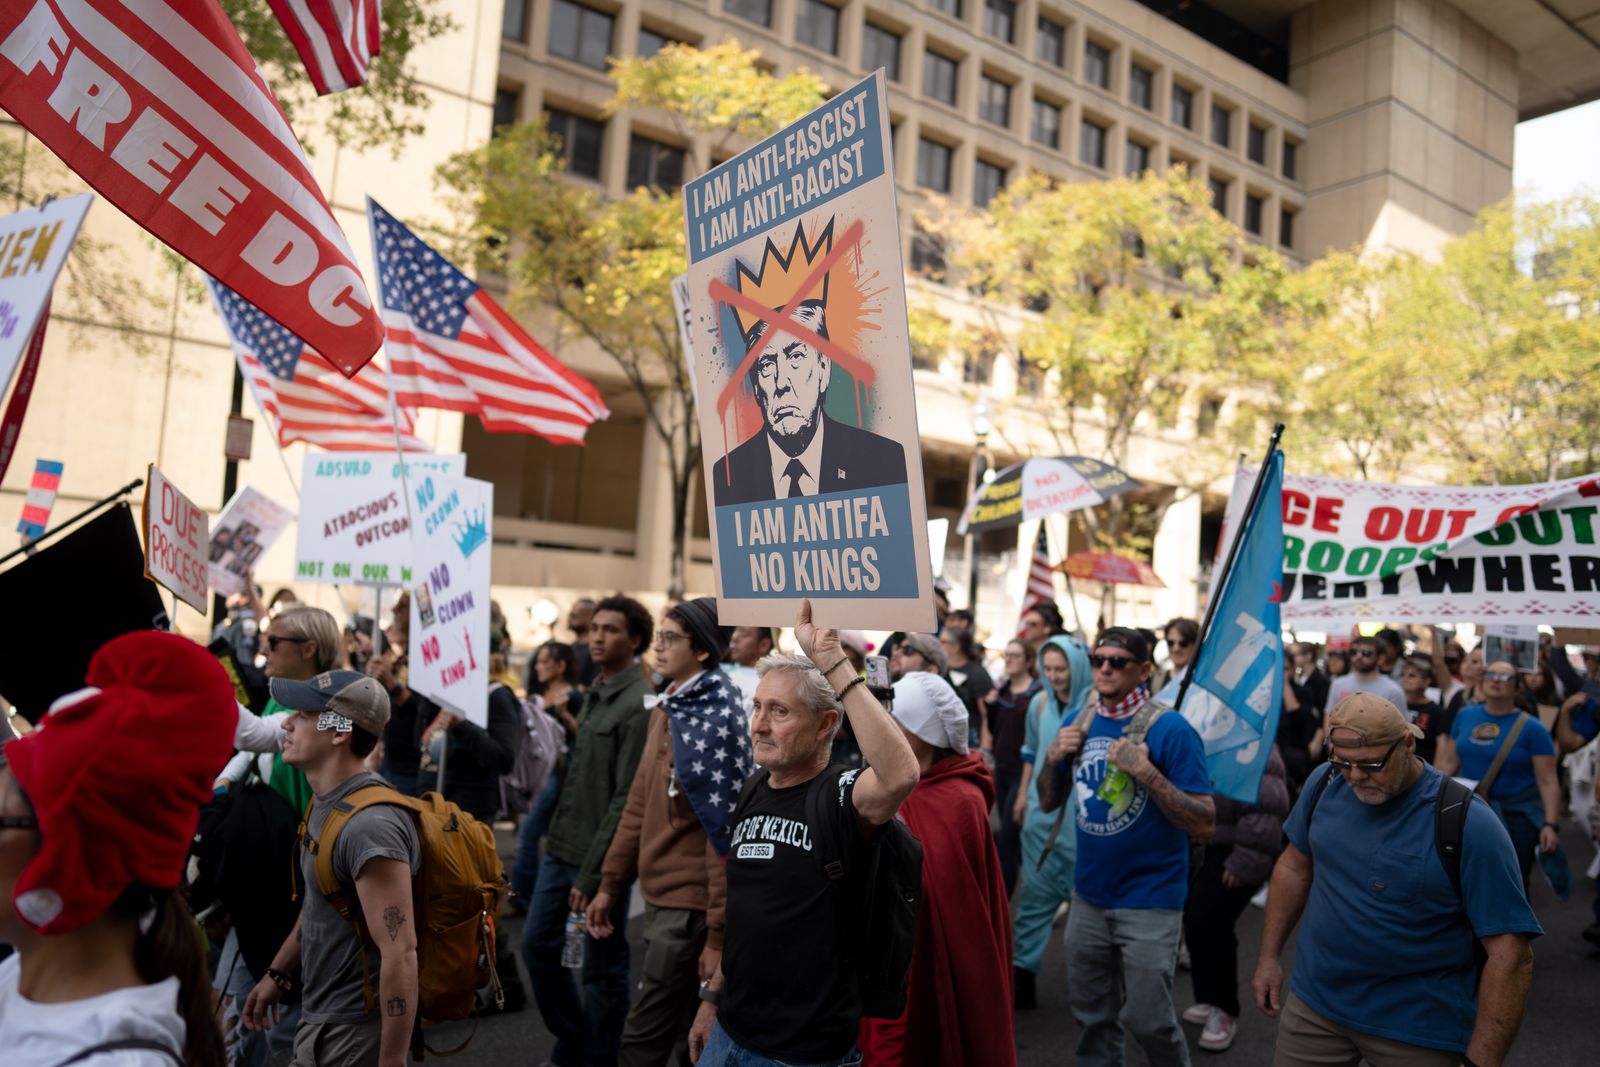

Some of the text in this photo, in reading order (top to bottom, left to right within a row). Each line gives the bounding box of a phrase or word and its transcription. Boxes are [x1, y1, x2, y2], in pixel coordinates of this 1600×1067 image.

[0, 0, 372, 327] FREE DC
[693, 90, 868, 218] I AM ANTI-FASCIST
[700, 139, 865, 252] I AM ANTI-RACIST
[315, 459, 372, 478] ABSURD
[161, 481, 201, 550] DUE
[323, 490, 399, 539] ATROCIOUS
[415, 476, 436, 513] NO
[424, 489, 461, 536] CROWN
[1282, 488, 1475, 544] CE OUT
[734, 495, 890, 547] I AM ANTIFA
[151, 523, 207, 599] PROCESS
[298, 560, 324, 577] NOT
[332, 561, 351, 578] ON
[362, 563, 390, 581] OUR
[430, 562, 450, 596] NO
[749, 546, 881, 592] NO KINGS
[1283, 534, 1449, 579] ROOPS
[437, 590, 475, 625] CLOWN
[420, 634, 441, 668] NO
[746, 815, 765, 840] OF
[740, 846, 770, 857] EST 1550
